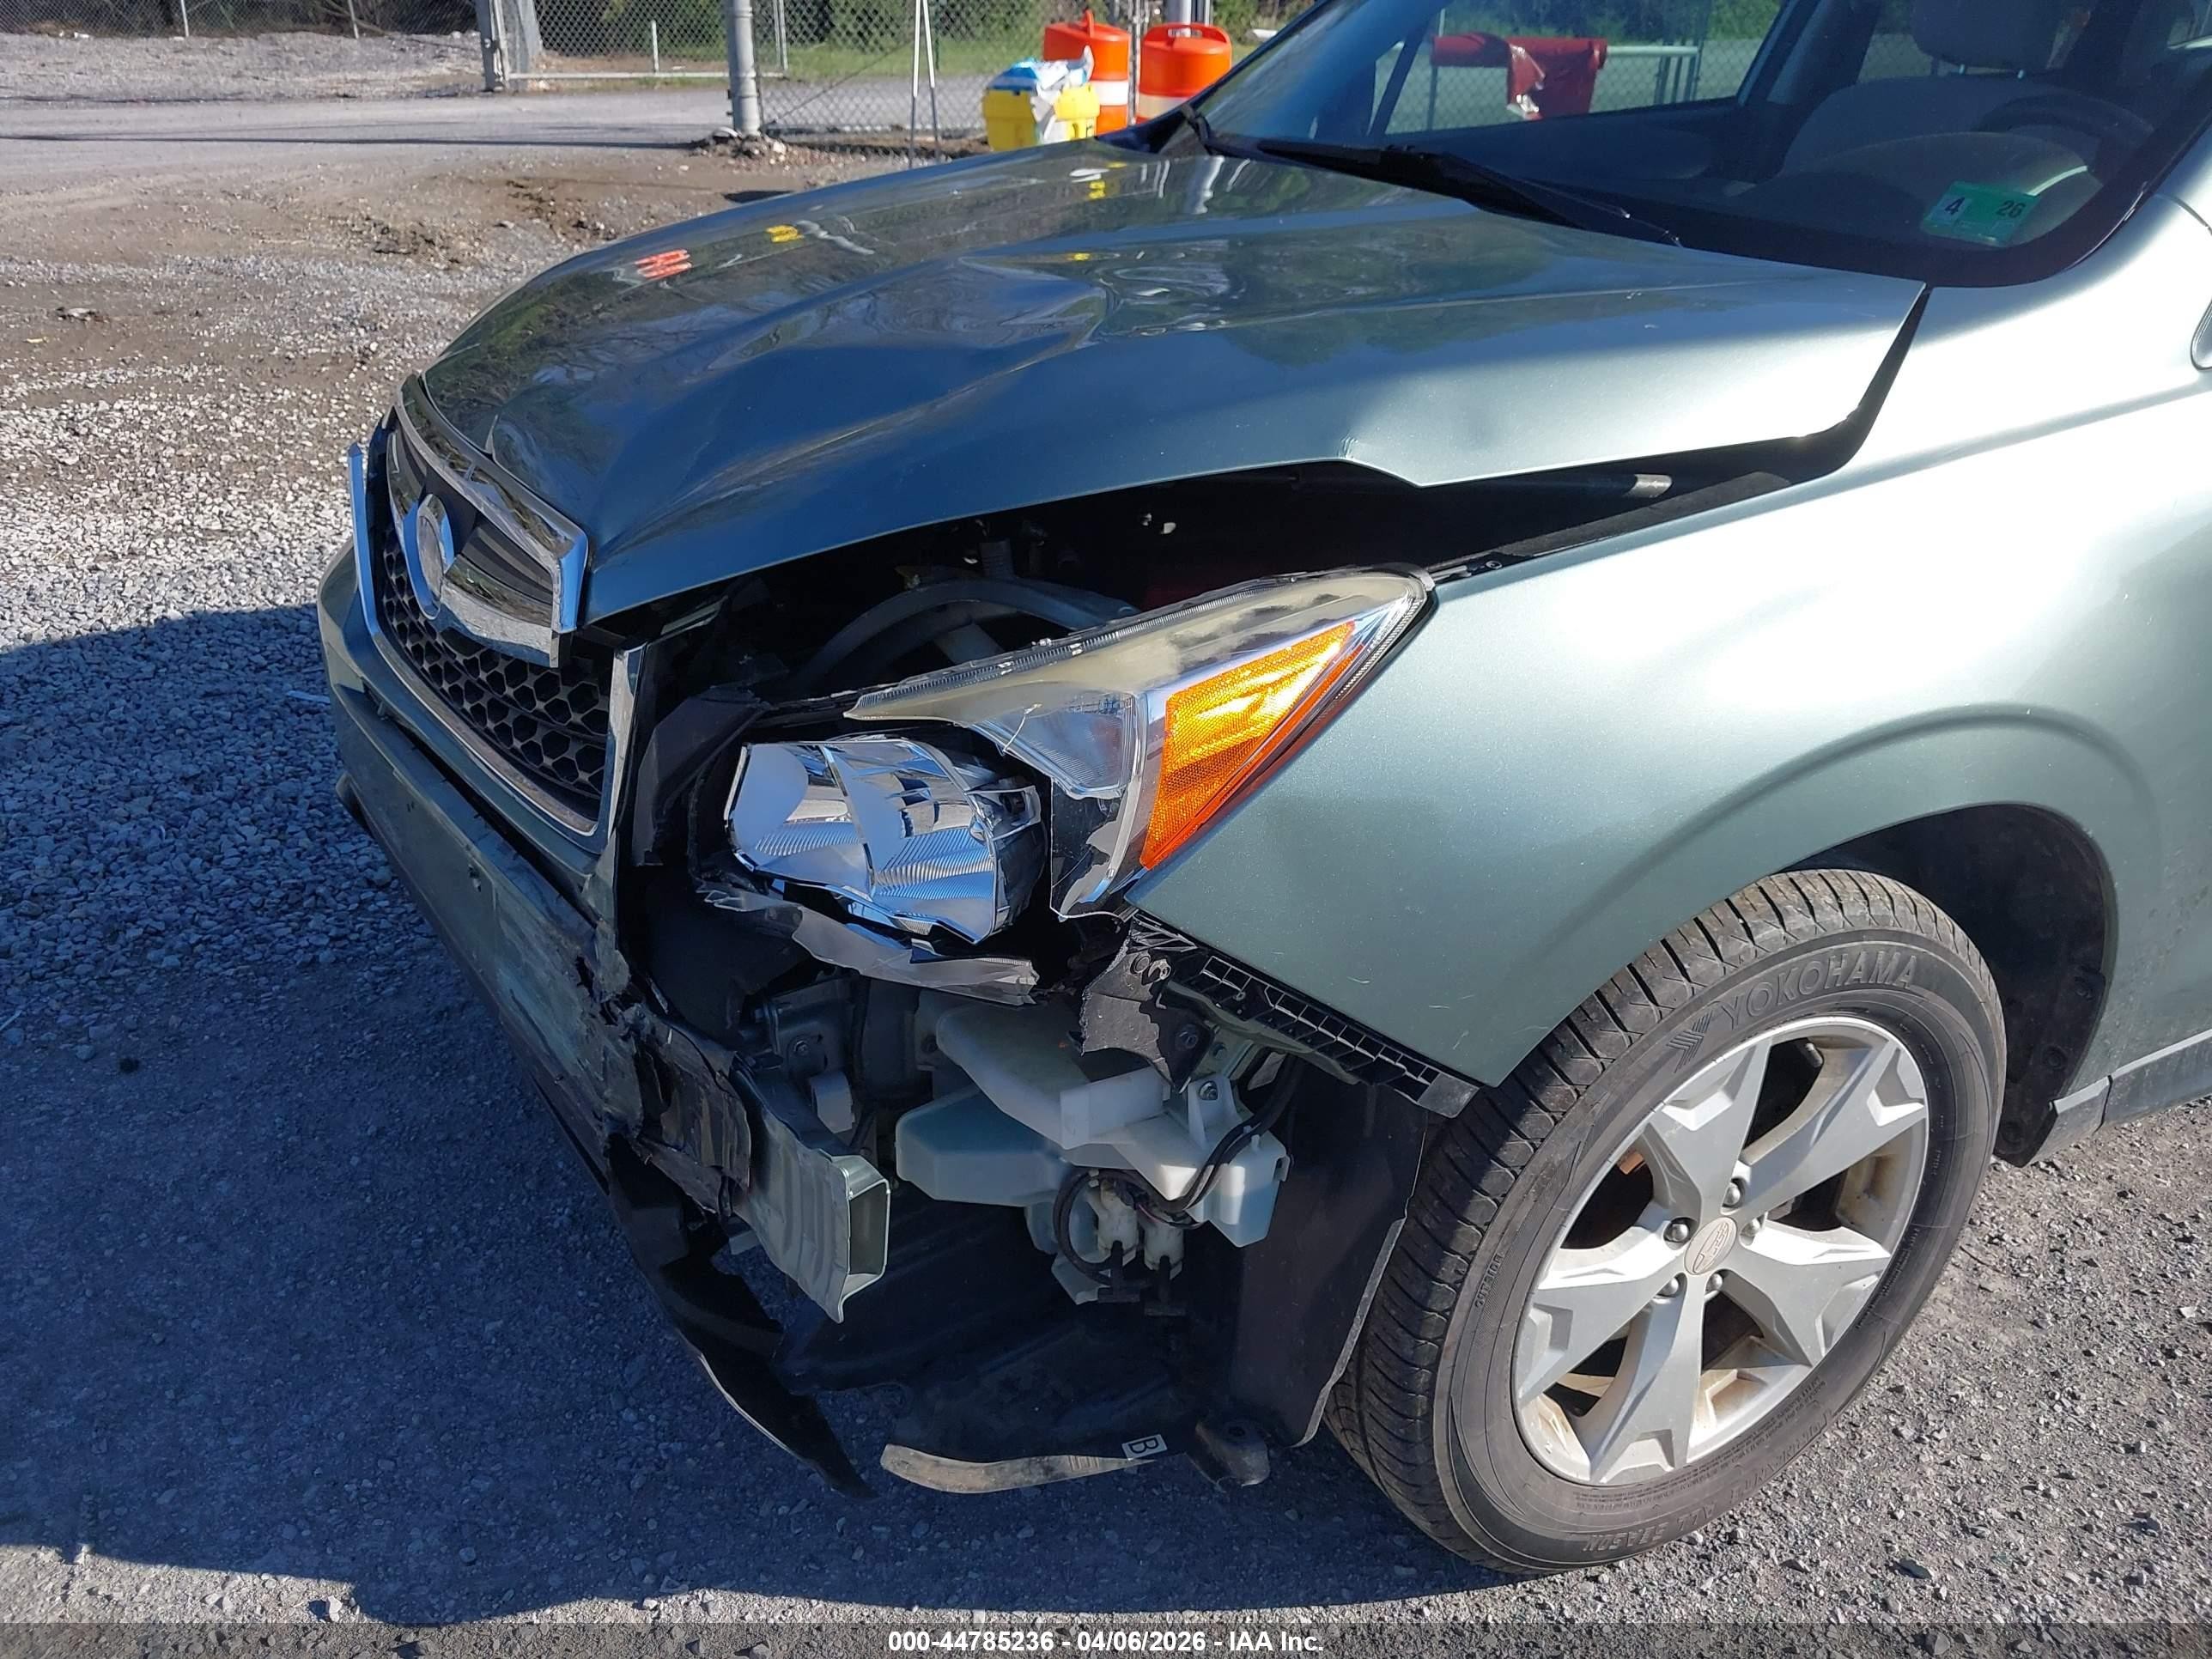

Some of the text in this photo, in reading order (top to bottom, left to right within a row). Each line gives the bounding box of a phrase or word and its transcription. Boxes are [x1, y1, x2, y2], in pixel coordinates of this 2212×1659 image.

[1944, 197, 2027, 218] 4 26
[1721, 951, 1917, 1030] YOKOHAMA
[1127, 1437, 1159, 1454] B
[1583, 1504, 1715, 1551] ALL SEASON
